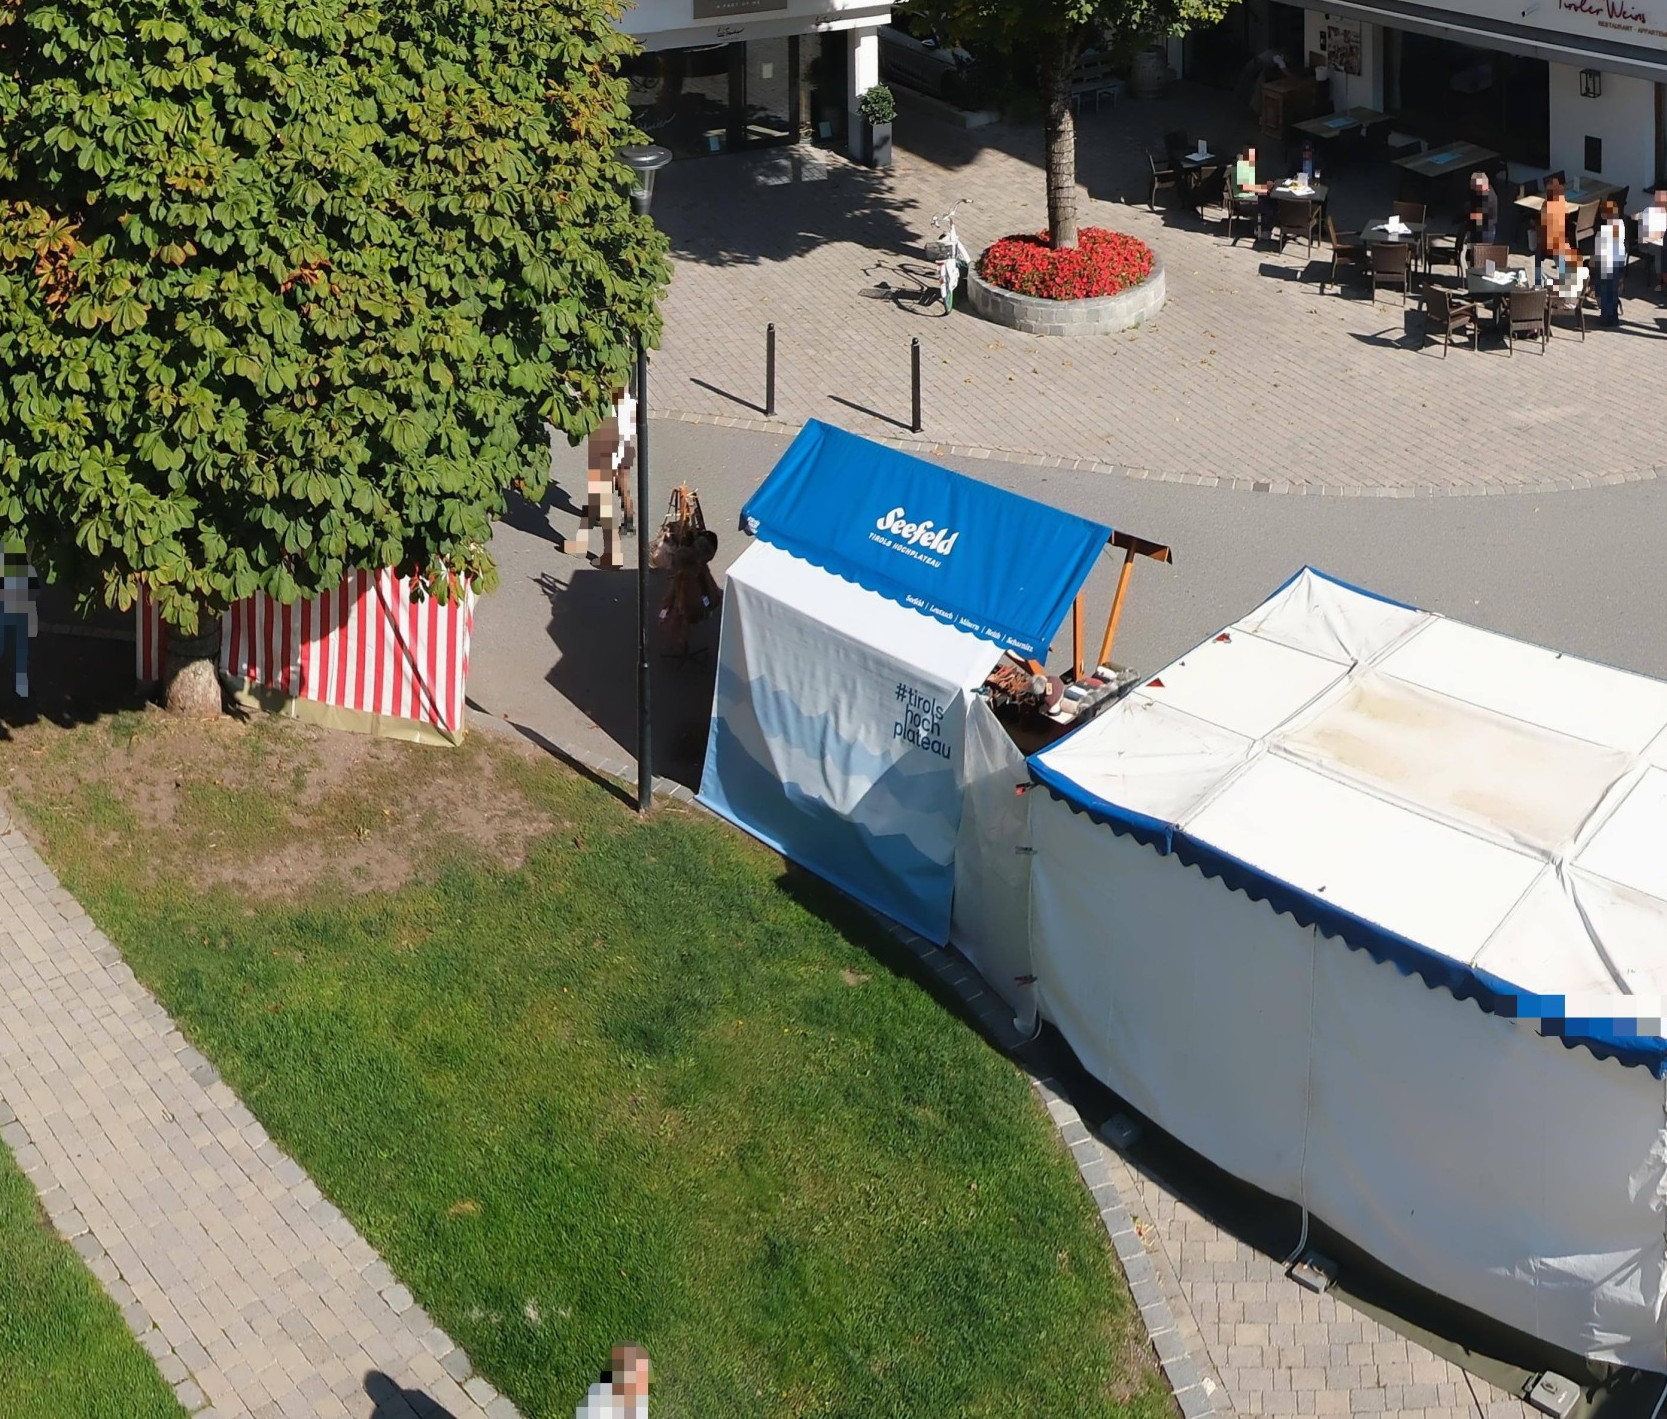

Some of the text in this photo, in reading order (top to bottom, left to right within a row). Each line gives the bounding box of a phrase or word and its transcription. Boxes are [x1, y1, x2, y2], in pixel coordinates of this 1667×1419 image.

[1598, 21, 1633, 32] RESTAURANT
[867, 531, 942, 569] TIROLS HOCHPLATEAU
[875, 507, 959, 556] Seefeld
[895, 683, 945, 721] #tirols
[892, 722, 952, 761] plateau
[905, 708, 941, 738] hoch
